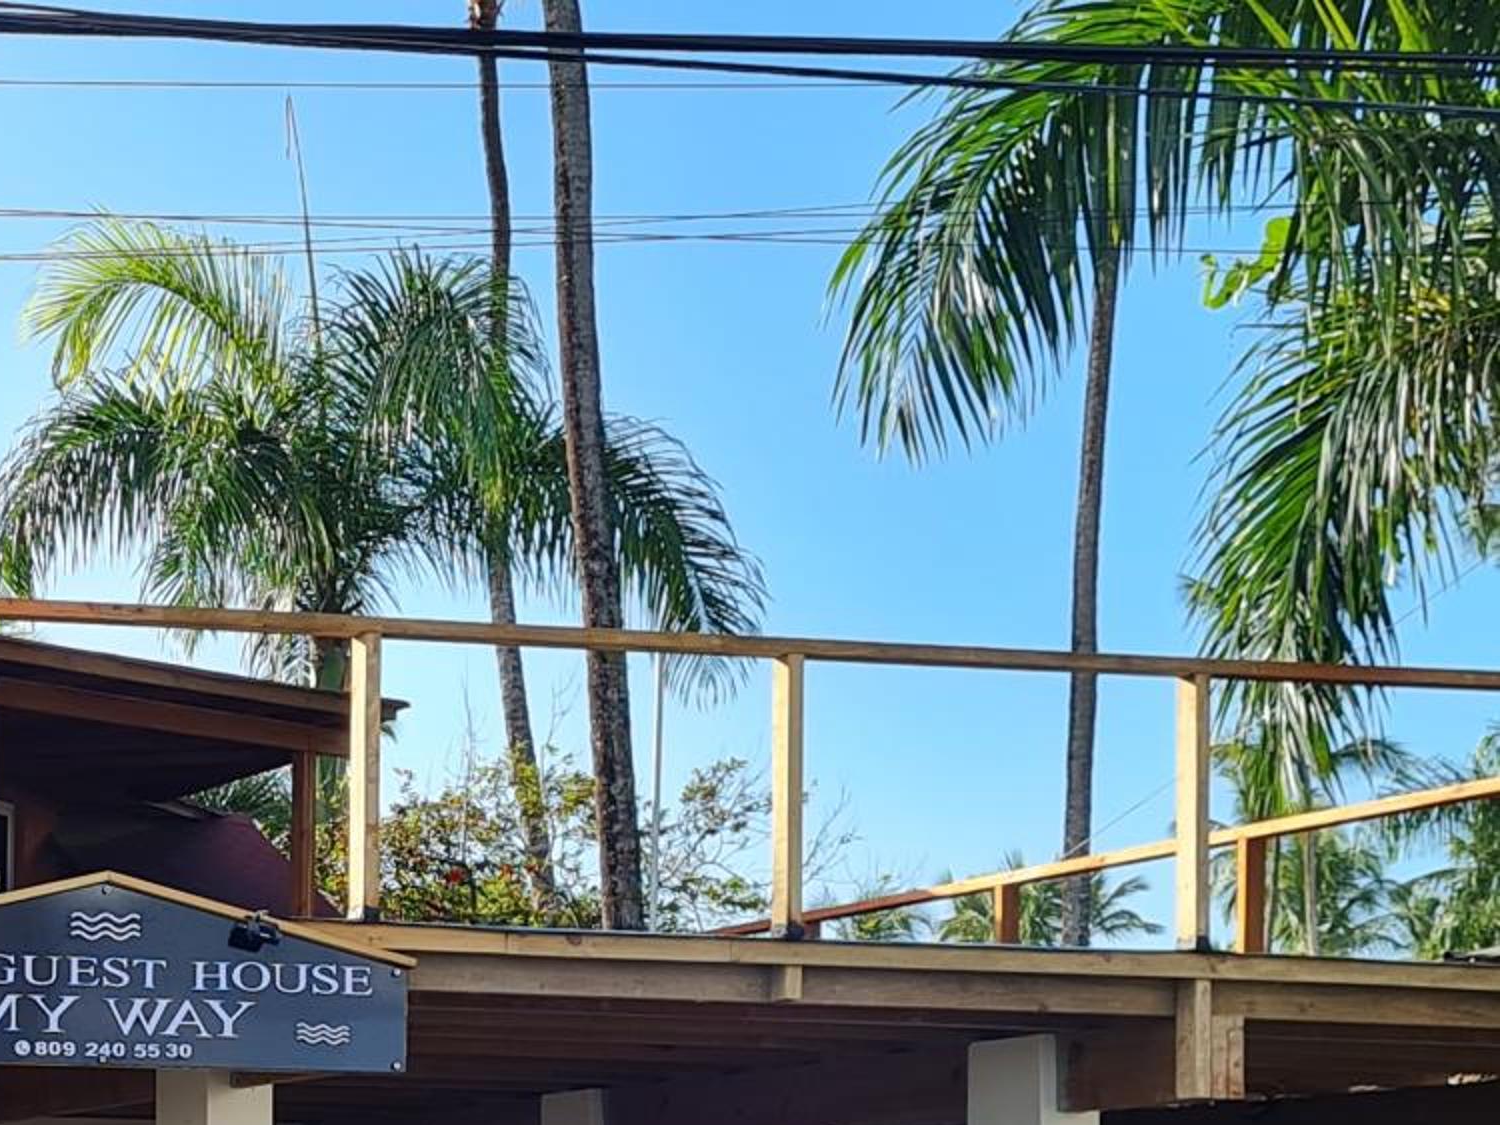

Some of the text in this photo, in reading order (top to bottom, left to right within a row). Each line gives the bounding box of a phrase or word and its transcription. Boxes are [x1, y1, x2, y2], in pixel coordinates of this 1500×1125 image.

[193, 960, 373, 997] HOUSE
[103, 997, 256, 1039] WAY
[34, 1041, 193, 1059] 809 240 55 30
